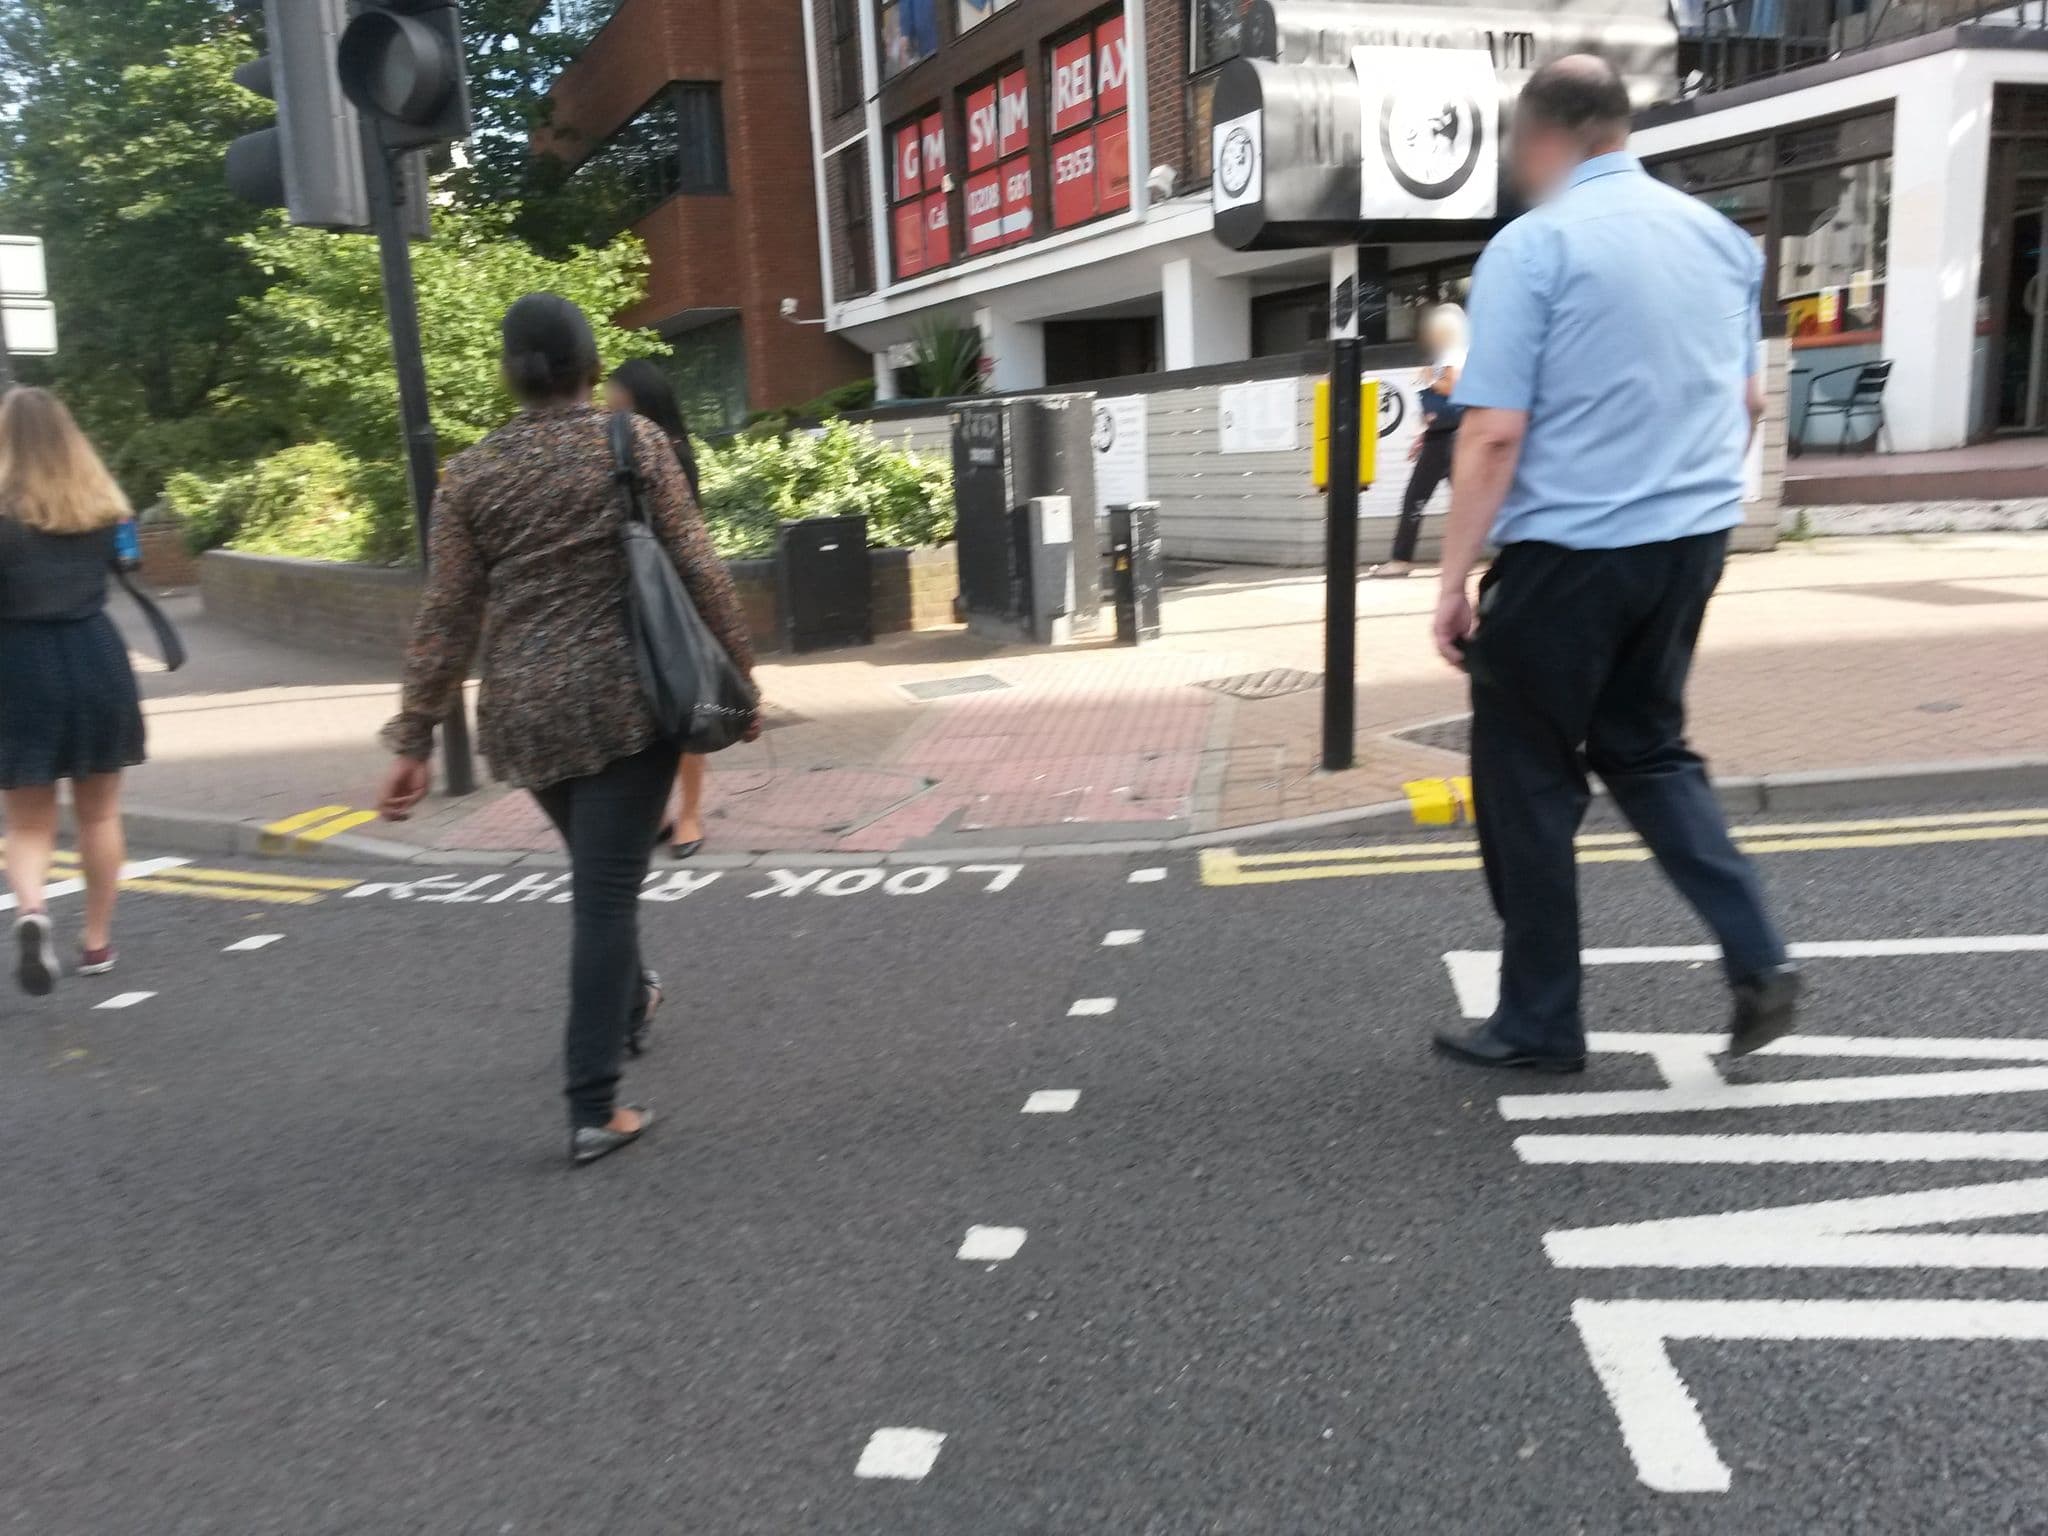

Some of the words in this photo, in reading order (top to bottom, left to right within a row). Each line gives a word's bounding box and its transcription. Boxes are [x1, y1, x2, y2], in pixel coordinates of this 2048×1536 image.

[903, 128, 946, 180] GYM
[969, 86, 1029, 153] SWIM
[1057, 37, 1129, 114] RELAX
[412, 870, 723, 904] RHT
[746, 864, 1025, 899] LOOK
